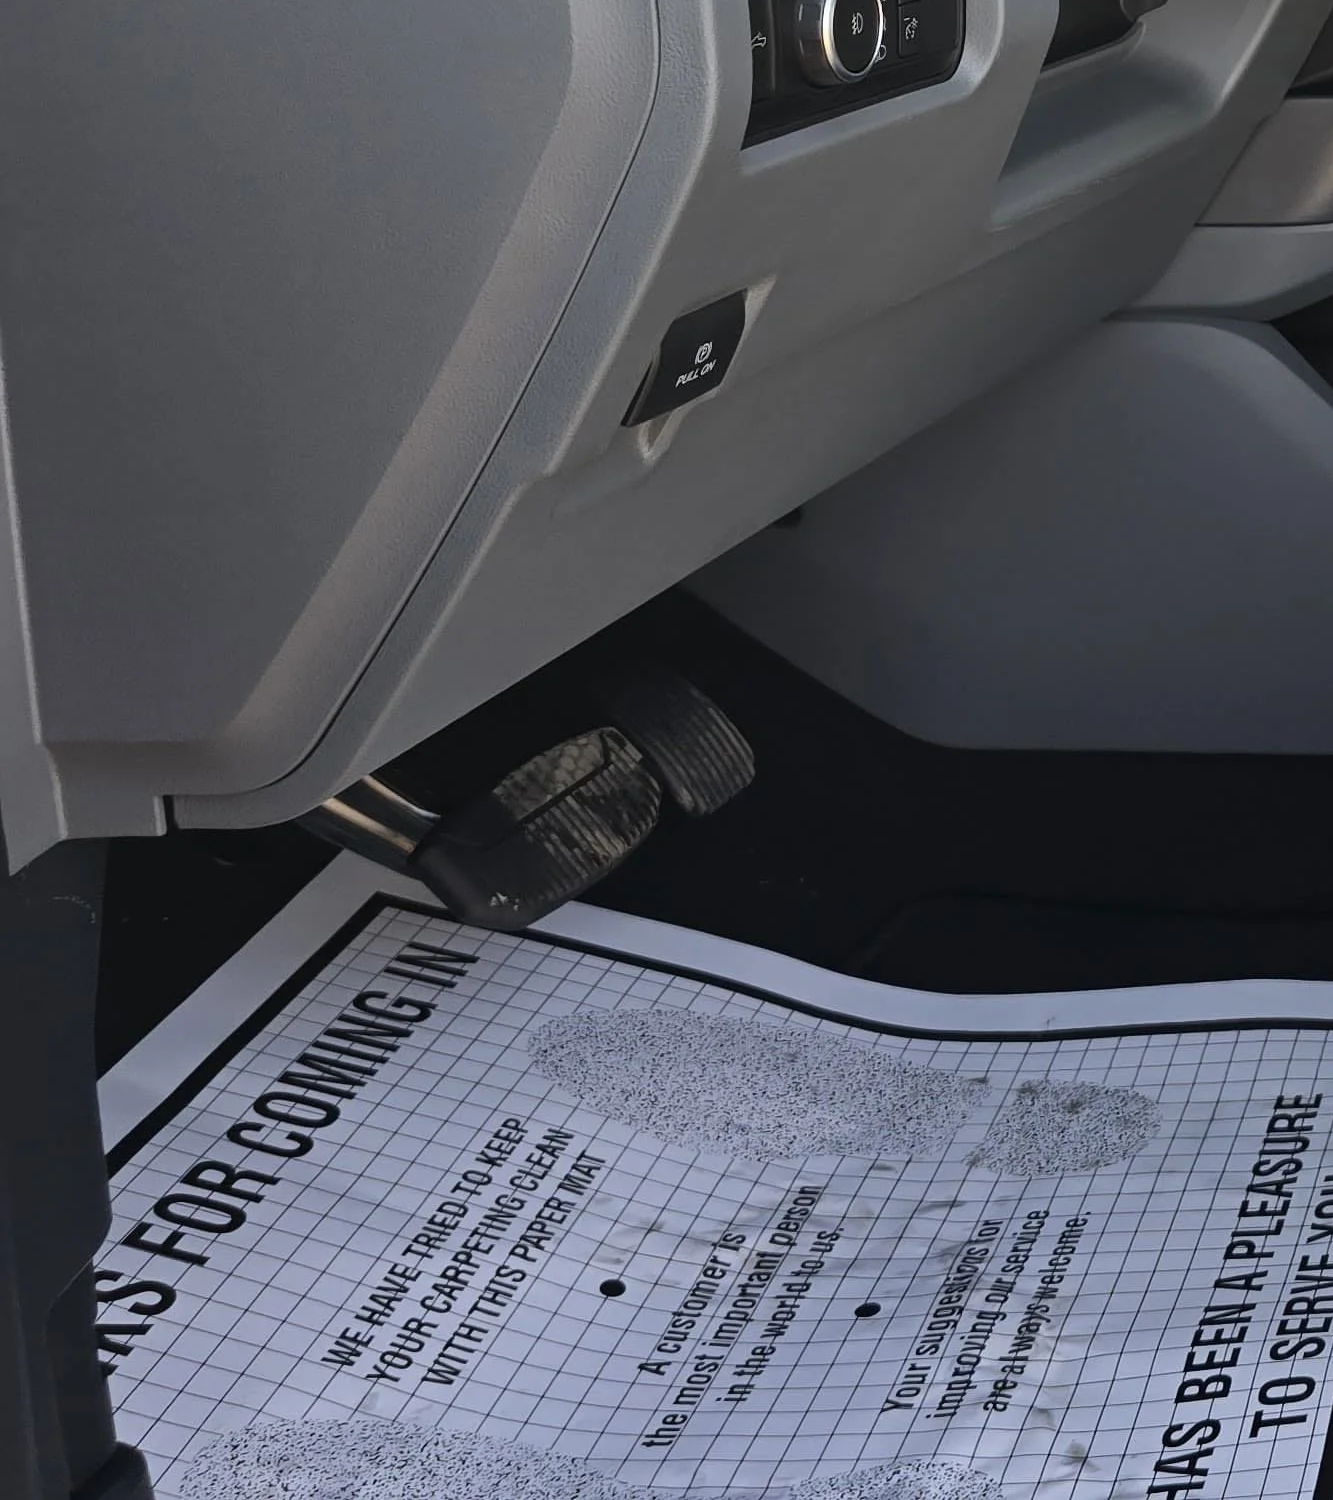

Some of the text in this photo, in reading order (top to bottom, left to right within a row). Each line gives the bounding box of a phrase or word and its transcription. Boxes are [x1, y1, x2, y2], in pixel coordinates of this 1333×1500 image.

[675, 359, 717, 388] PULL ON
[120, 1160, 283, 1267] FOR
[226, 990, 439, 1159] COMING
[382, 941, 480, 989] IN
[1223, 1092, 1323, 1261] PLEASURE
[321, 1117, 529, 1367] WE HAVE TRIED TO KEEP
[365, 1128, 575, 1383] YOUR CARPETING CLEAN
[421, 1150, 607, 1386] WITH THIS PAPER MAT
[791, 1259, 826, 1278] to
[1214, 1270, 1268, 1292] A
[637, 1232, 746, 1376] A customer is
[641, 1184, 824, 1448] the most important person
[760, 1282, 812, 1339] world
[879, 1219, 1004, 1414] Your suggestions for
[926, 1209, 1049, 1419] improving our service
[999, 1302, 1051, 1376] always
[1174, 1303, 1252, 1404] BEEN
[715, 1382, 755, 1402] in
[733, 1344, 776, 1378] the
[983, 1378, 1018, 1412] are
[1249, 1375, 1316, 1438] TO
